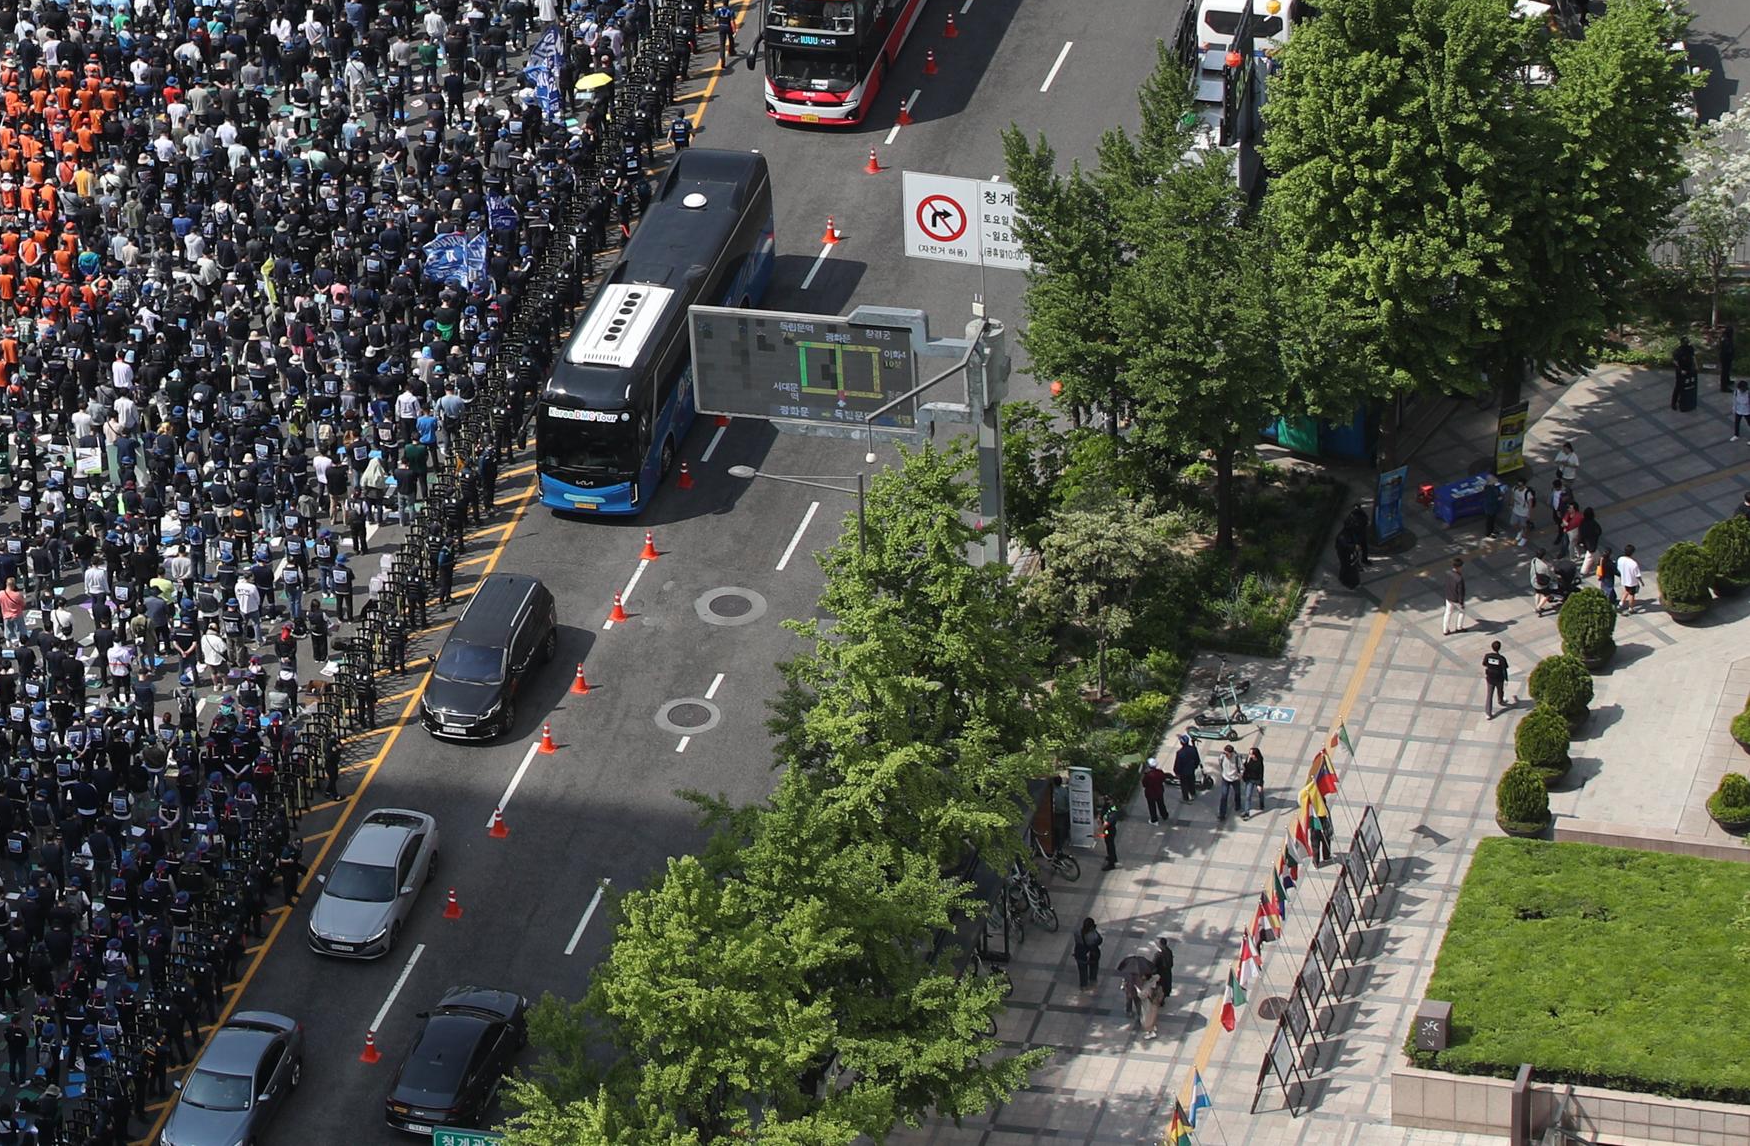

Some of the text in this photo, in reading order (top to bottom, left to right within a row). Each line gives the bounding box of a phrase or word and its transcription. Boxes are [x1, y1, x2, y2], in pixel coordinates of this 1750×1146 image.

[918, 244, 968, 258] (자전거 허용)
[779, 321, 814, 333] 독립문역
[825, 332, 851, 344] 광화문
[772, 381, 799, 392] 서대문
[779, 405, 810, 417] 광화문
